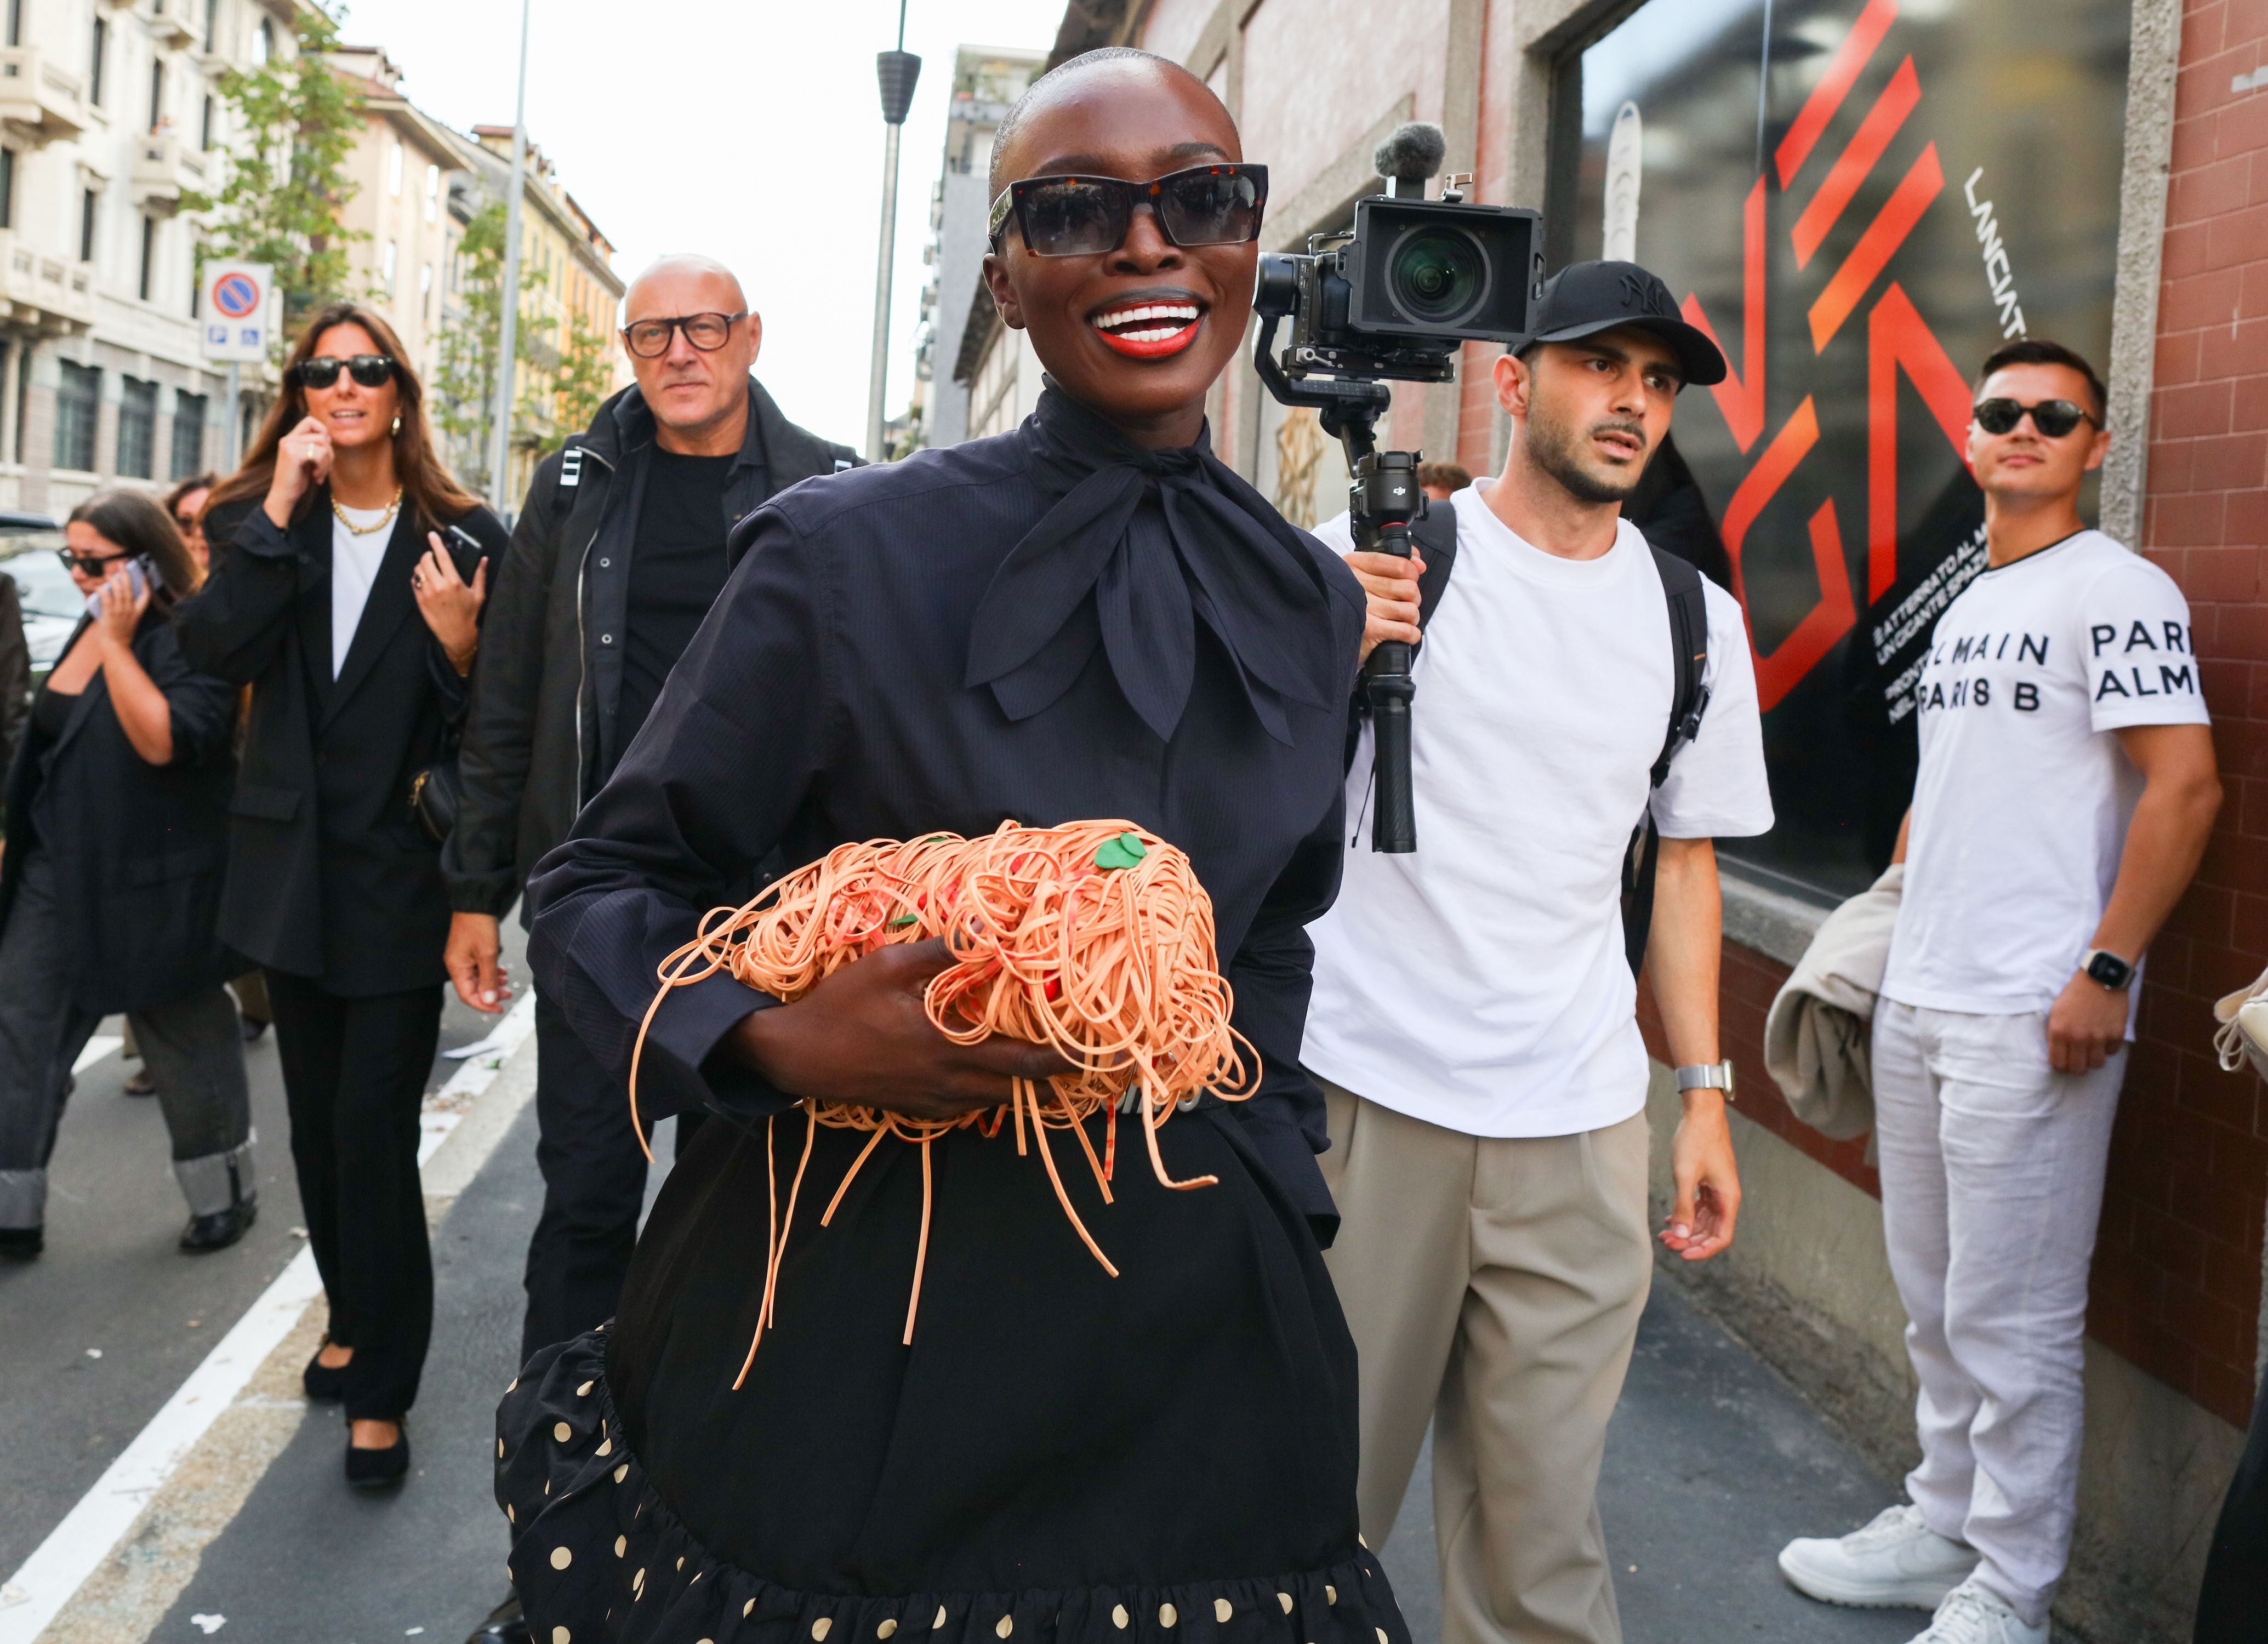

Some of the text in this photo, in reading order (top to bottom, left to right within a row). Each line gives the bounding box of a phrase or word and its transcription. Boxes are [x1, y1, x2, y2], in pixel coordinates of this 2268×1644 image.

[1964, 166, 2028, 342] LANCIAT
[1883, 554, 1957, 638] ATTERRATO
[1957, 540, 1976, 566] AL
[1877, 638, 1896, 666] UN
[1924, 633, 2049, 666] LMAIN
[1884, 648, 1933, 701] PRONT
[2095, 665, 2203, 703] ALM
[1889, 694, 1917, 725] NEL
[1919, 678, 2040, 715] PARIS B
